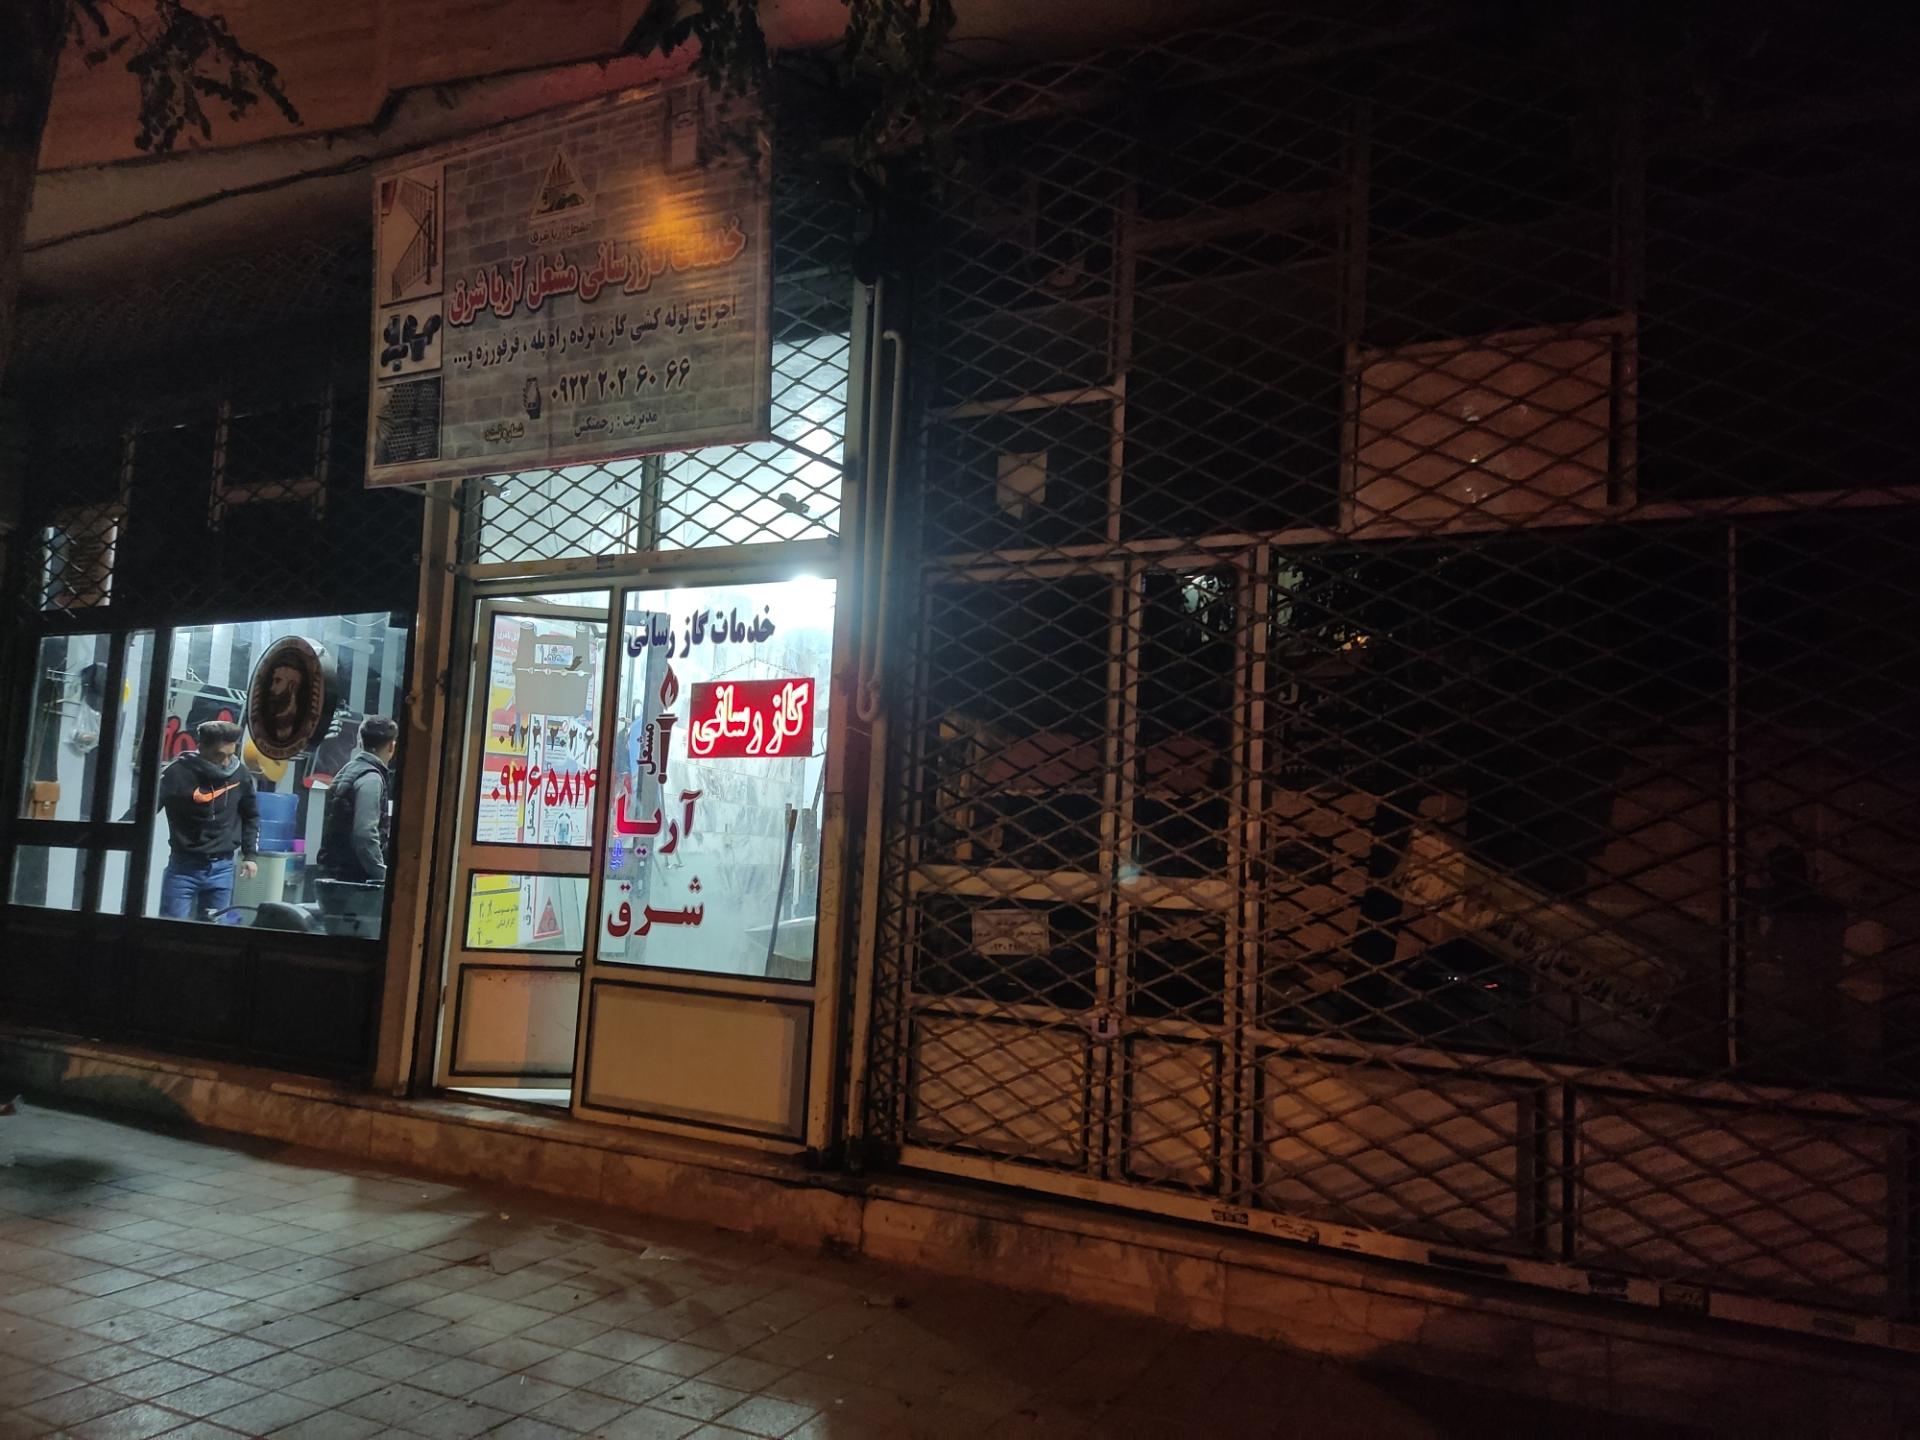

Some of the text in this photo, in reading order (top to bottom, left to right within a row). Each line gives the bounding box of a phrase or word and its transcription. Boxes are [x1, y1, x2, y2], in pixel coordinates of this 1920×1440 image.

[450, 268, 488, 325] شرق
[486, 257, 526, 315] آریا
[527, 254, 579, 310] مشعل
[630, 307, 661, 341] کشی
[665, 303, 690, 334] لوله
[694, 295, 737, 330] اجرای
[665, 357, 691, 390] ۶۶
[626, 604, 776, 659] خدمات گاز رسانی
[692, 682, 809, 755] گاز رسانی
[636, 722, 657, 776] مشعل
[615, 788, 704, 857] آریا
[607, 875, 705, 938] شرق
